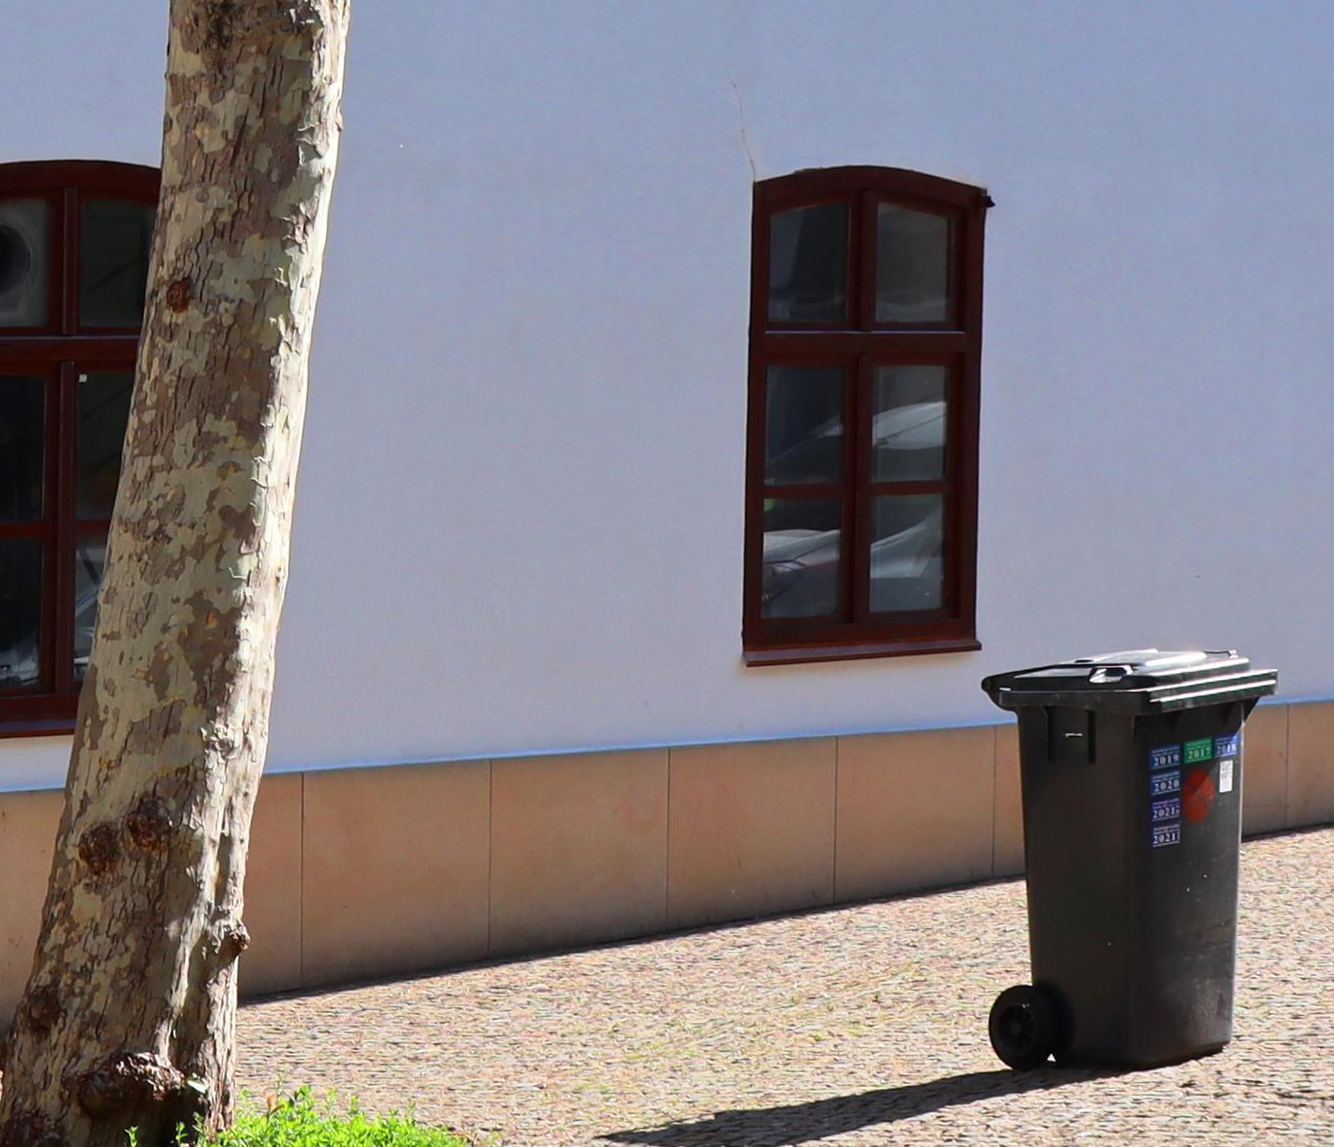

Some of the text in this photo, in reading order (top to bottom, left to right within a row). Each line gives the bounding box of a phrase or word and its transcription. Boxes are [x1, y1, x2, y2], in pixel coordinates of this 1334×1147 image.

[1187, 746, 1211, 759] 2017
[1153, 753, 1180, 767] 2019
[1154, 780, 1180, 792] 2020
